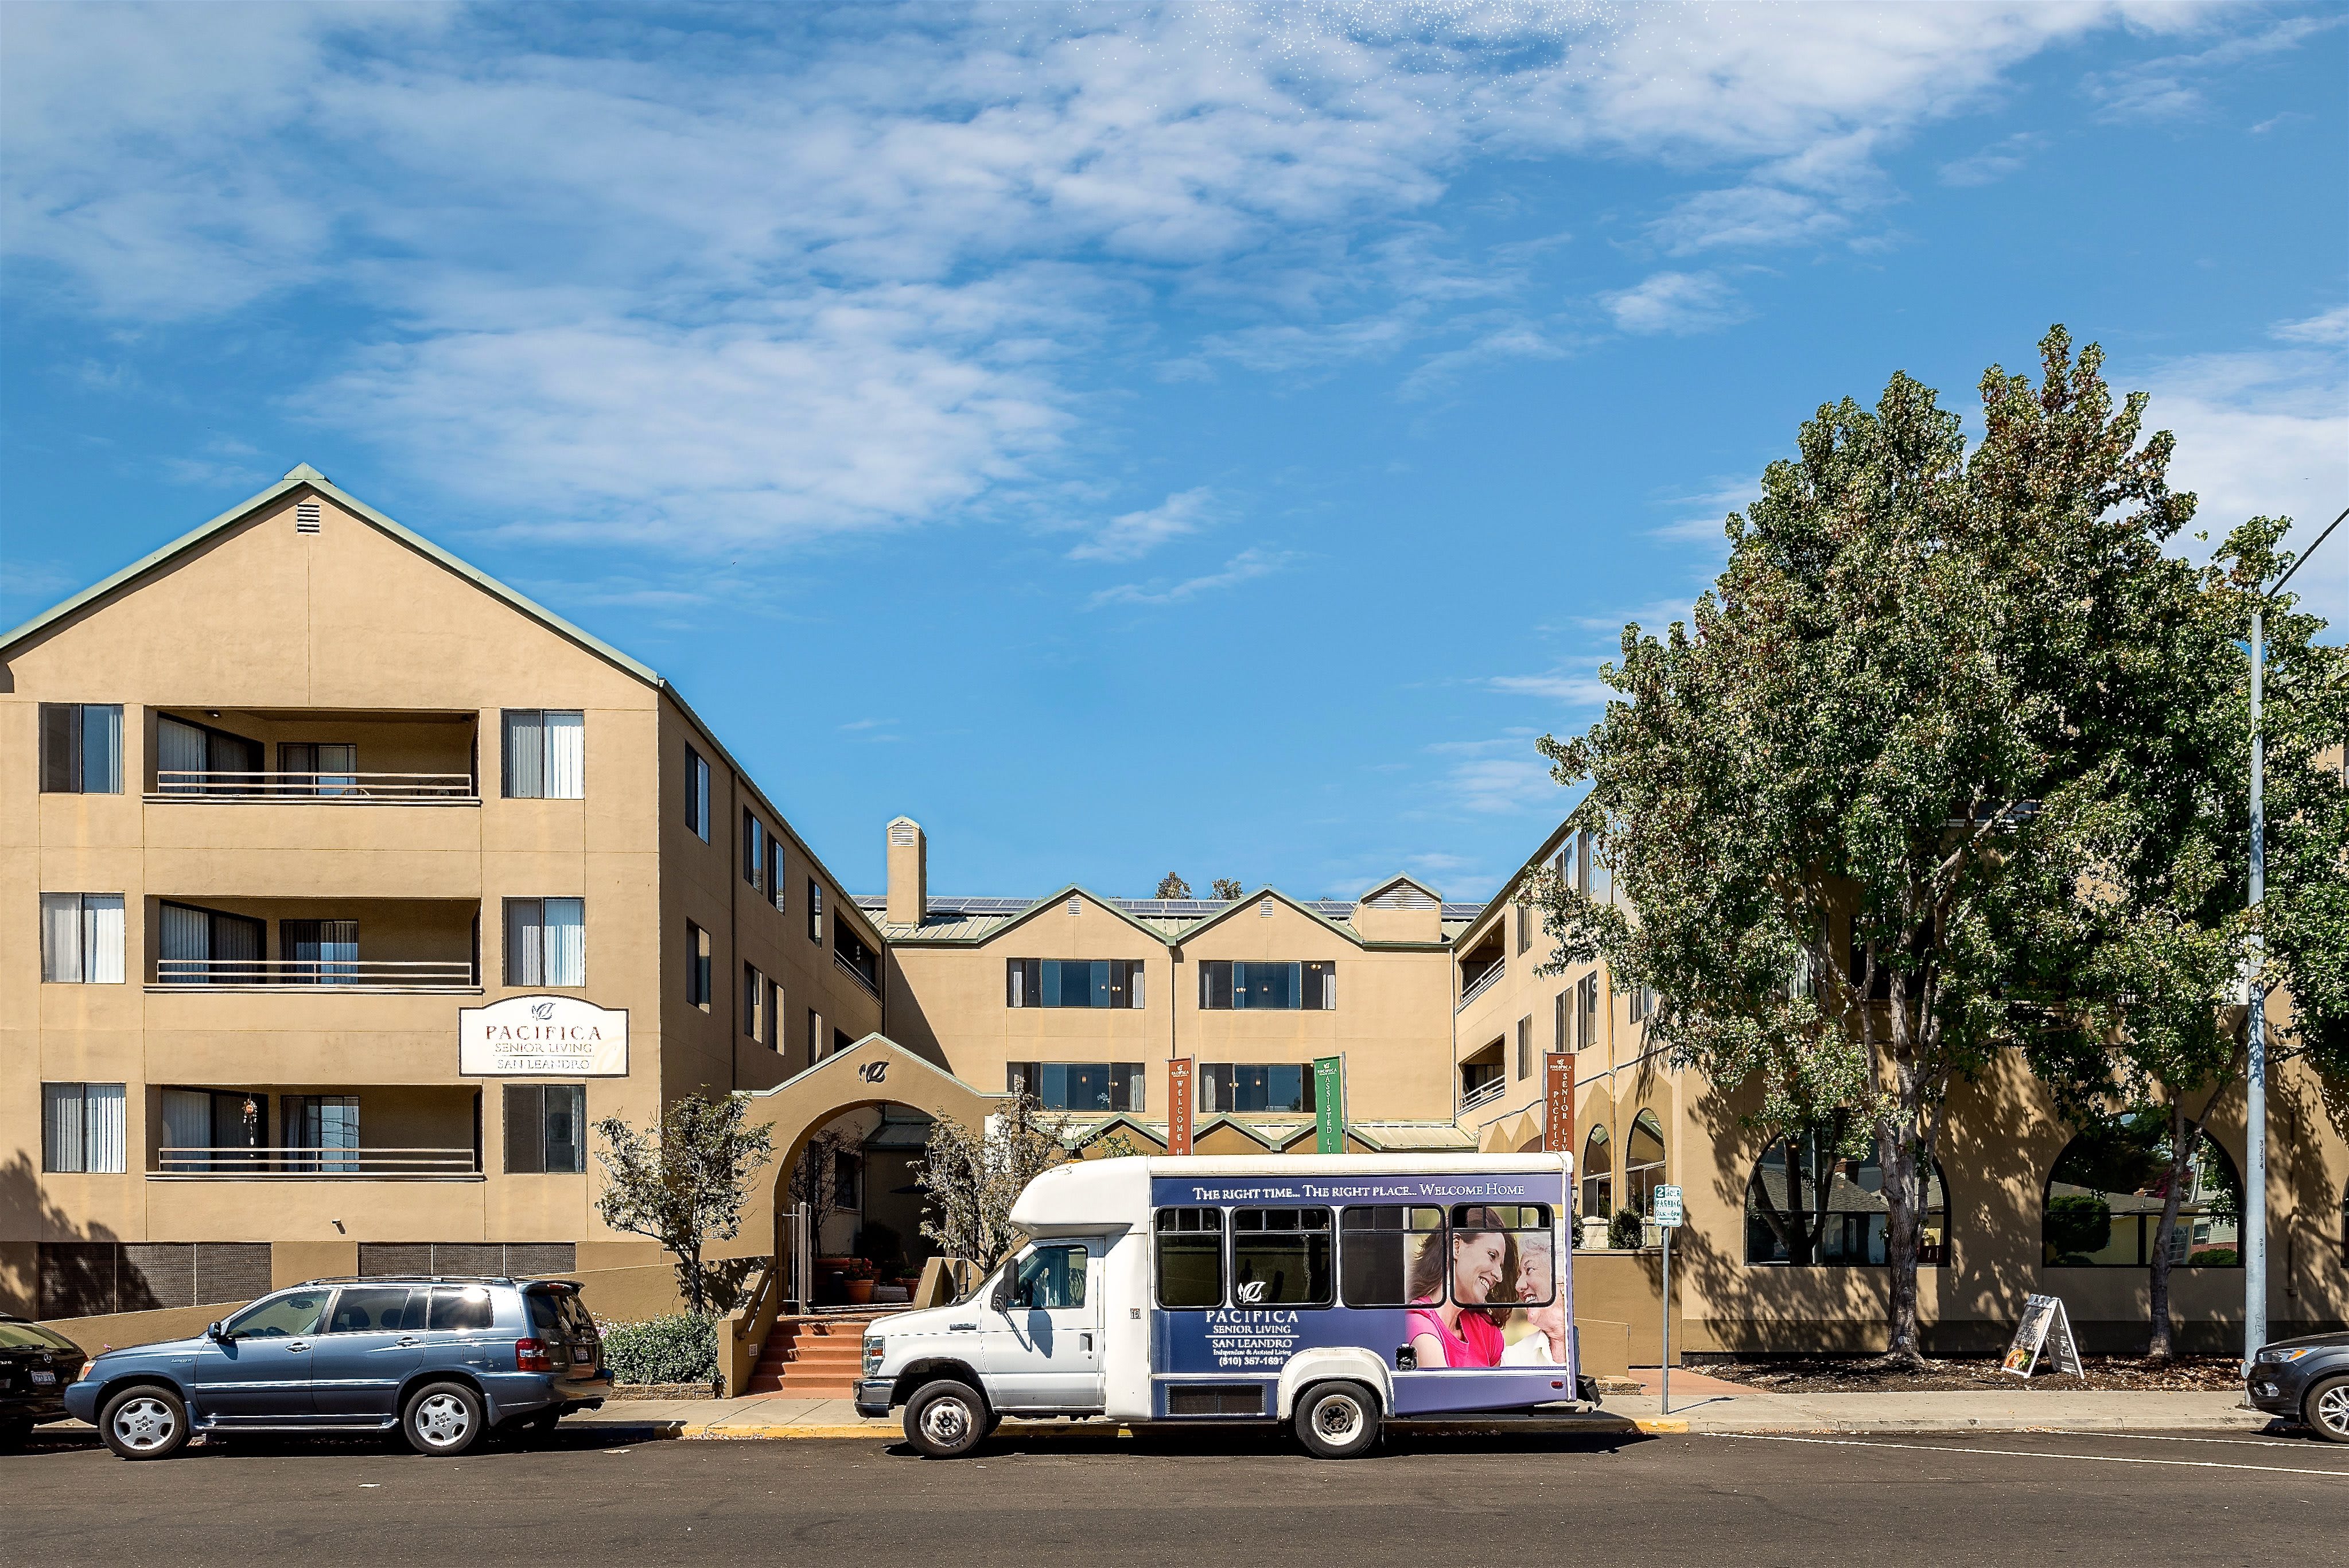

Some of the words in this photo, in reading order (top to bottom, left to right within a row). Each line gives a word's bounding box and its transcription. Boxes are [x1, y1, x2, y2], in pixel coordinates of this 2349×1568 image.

[486, 1026, 601, 1040] PACIFICA
[495, 1043, 545, 1052] SENIOR
[549, 1043, 592, 1053] LIVING
[497, 1060, 523, 1069] SAN
[527, 1060, 590, 1069] LEANDRO
[1193, 1187, 1220, 1200] THE
[1222, 1188, 1261, 1200] RIGHT
[1302, 1184, 1330, 1197] THE
[1332, 1185, 1370, 1197] RIGHT
[1418, 1183, 1483, 1196] WELCOME
[1485, 1182, 1525, 1195] HOME
[1657, 1188, 1664, 1197] 2
[1666, 1188, 1680, 1197] HOUR
[1656, 1200, 1681, 1208] PARKING
[1206, 1310, 1299, 1323] PACIFICA
[1213, 1325, 1253, 1334] SENIOR
[1255, 1325, 1291, 1334] LIVING
[1212, 1339, 1234, 1348] SAN
[1238, 1339, 1293, 1348] LEANDRO
[1219, 1356, 1242, 1367] (510)
